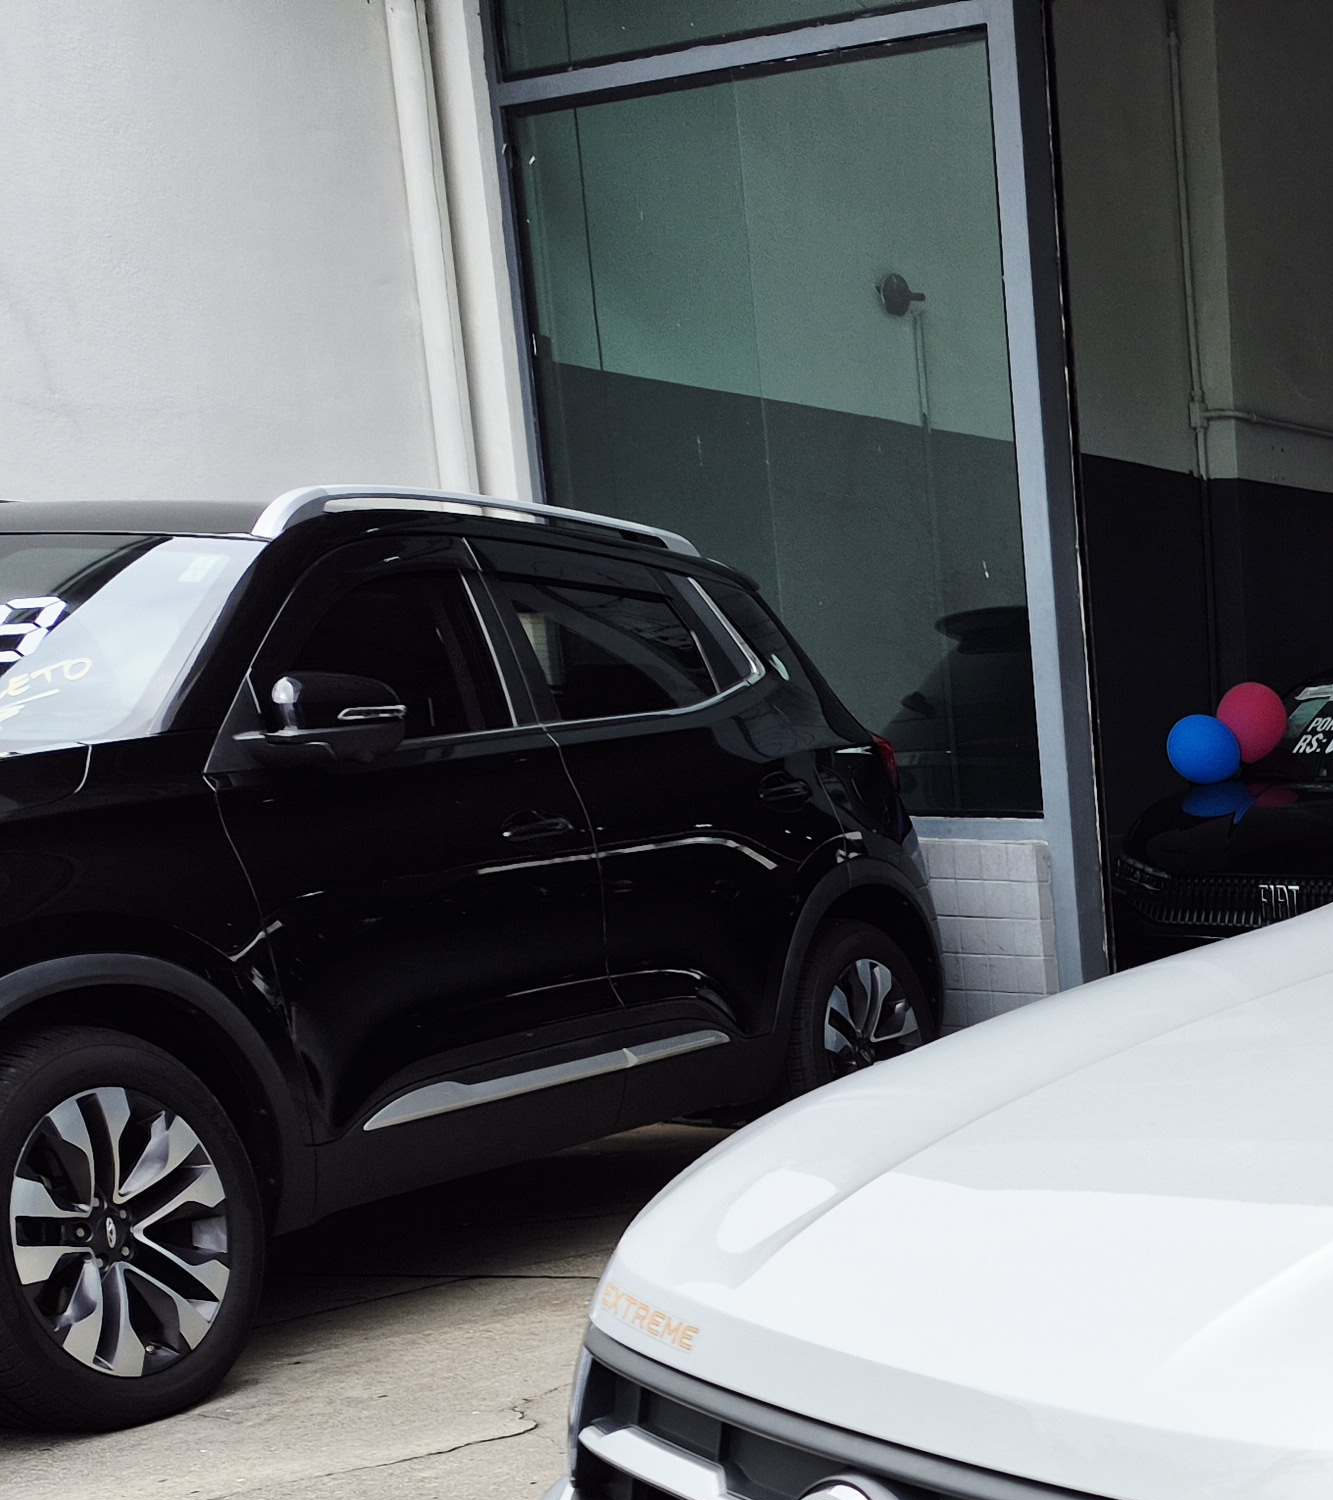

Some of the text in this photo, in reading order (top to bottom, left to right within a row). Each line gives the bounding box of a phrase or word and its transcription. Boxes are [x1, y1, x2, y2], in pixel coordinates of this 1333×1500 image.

[0, 657, 93, 700] ETO
[1258, 884, 1300, 919] FIAT
[602, 1281, 701, 1352] EXTREME
